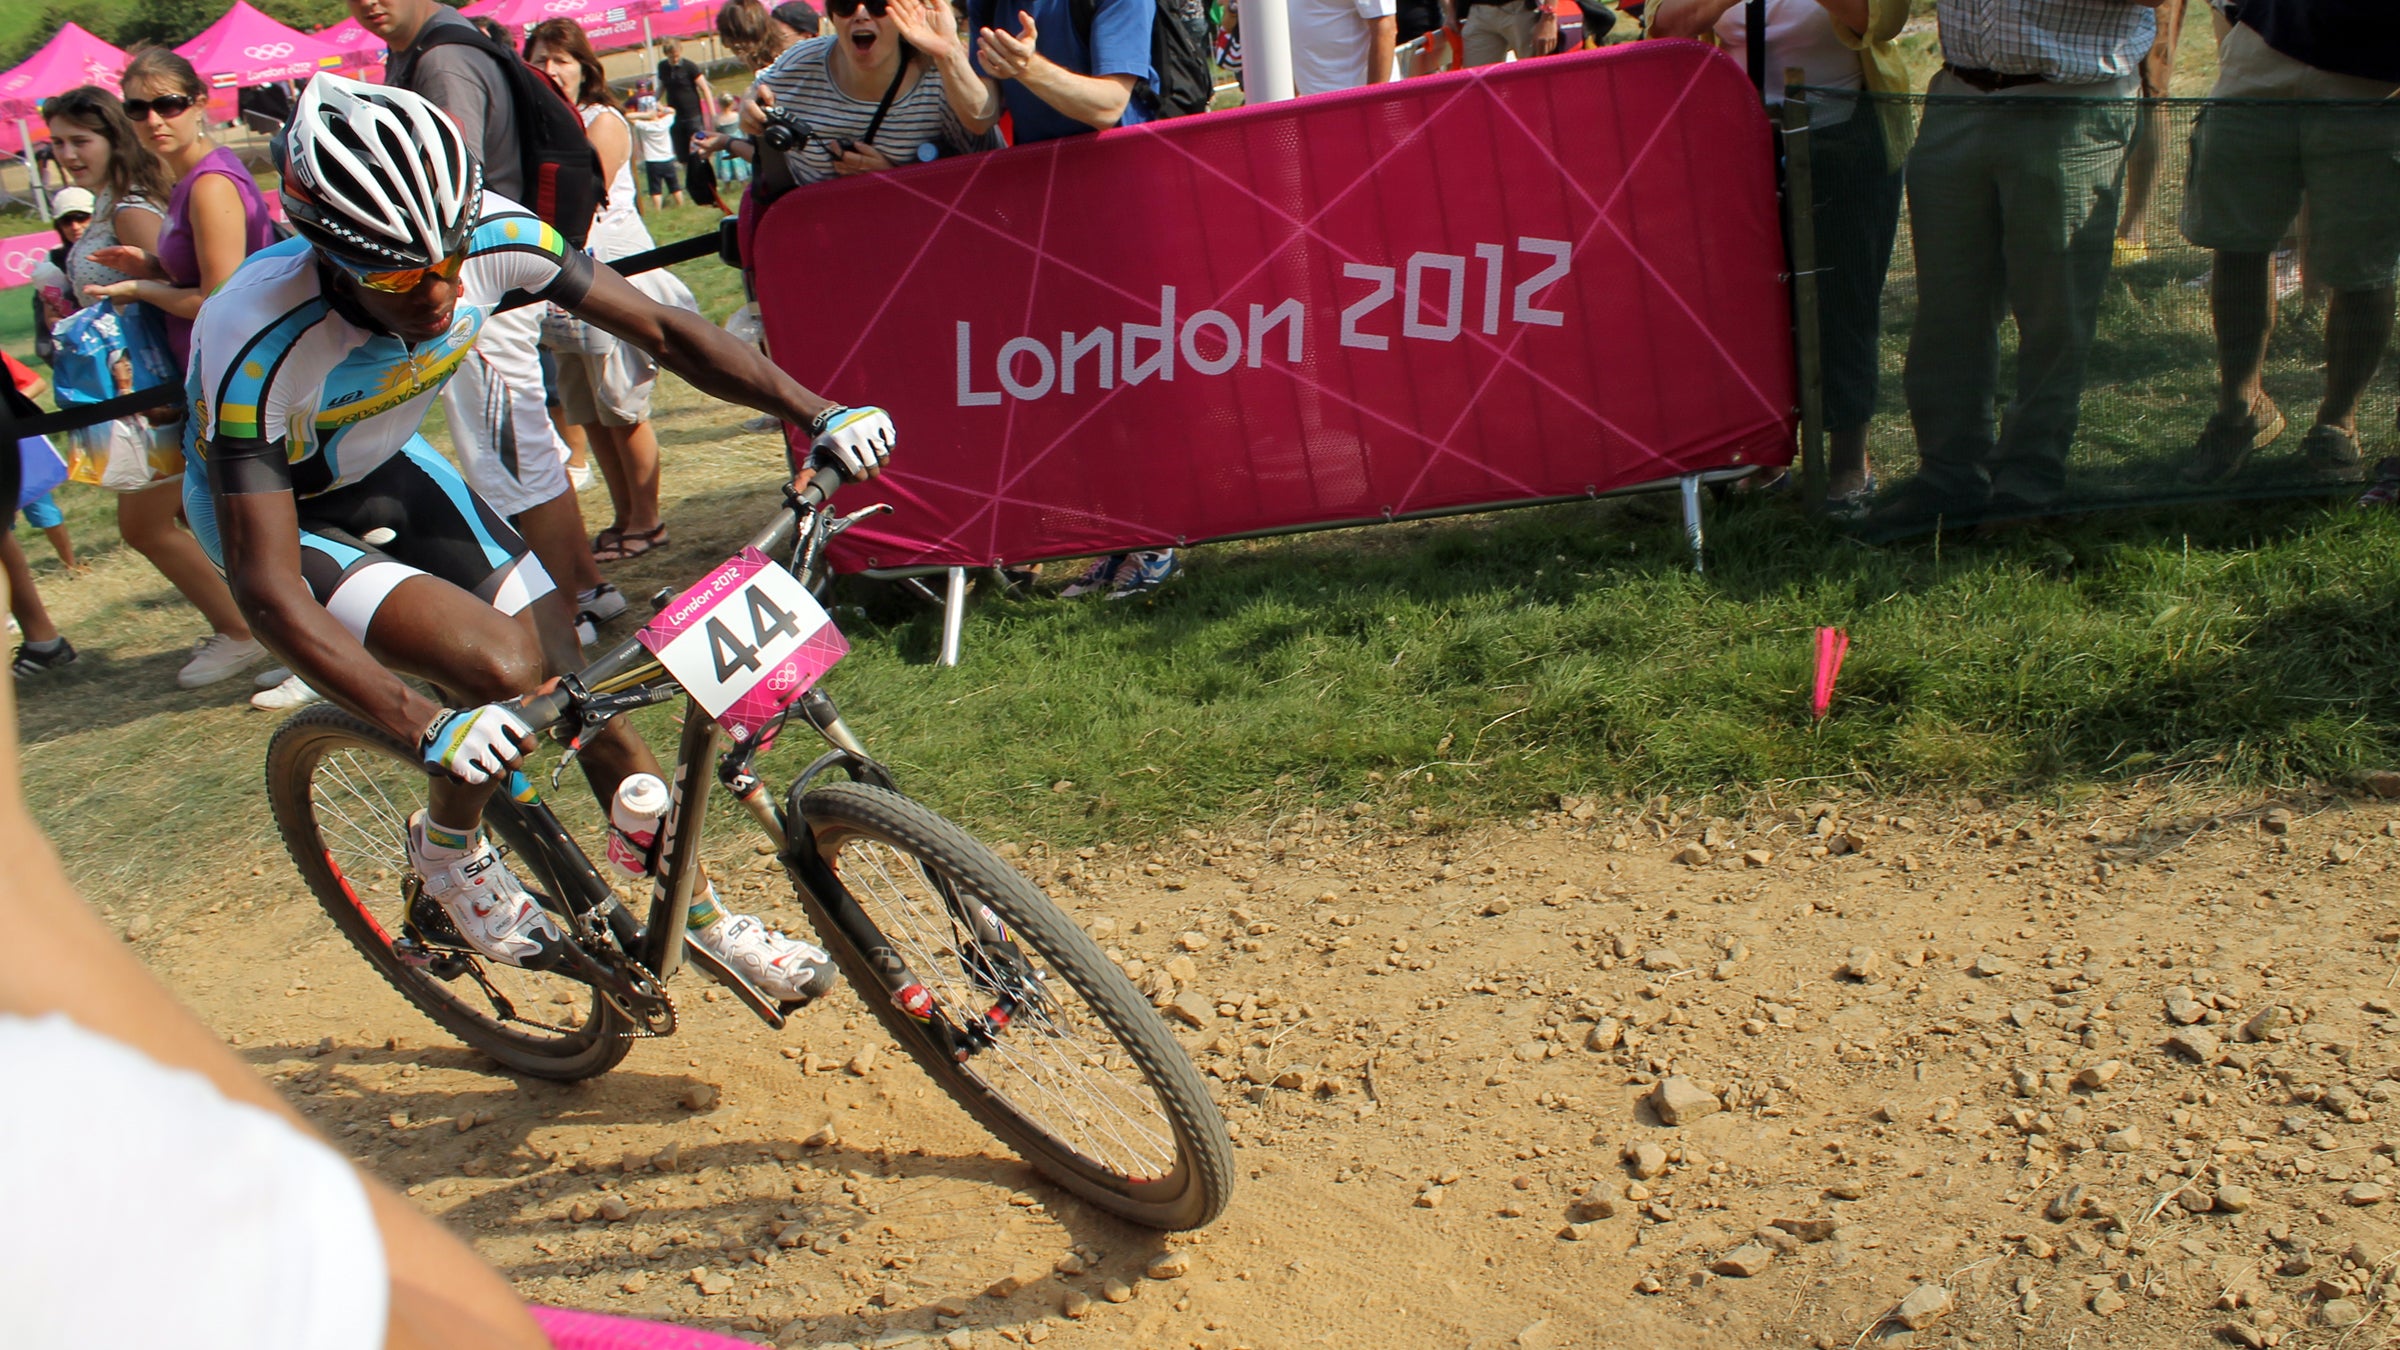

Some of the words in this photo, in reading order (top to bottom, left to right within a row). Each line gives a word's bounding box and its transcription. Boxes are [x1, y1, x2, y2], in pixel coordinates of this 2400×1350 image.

[956, 285, 1304, 406] London
[1340, 236, 1573, 350] 2012
[668, 588, 715, 627] London
[711, 566, 741, 592] 2012
[705, 583, 802, 685] 44
[464, 852, 496, 878] SIDI
